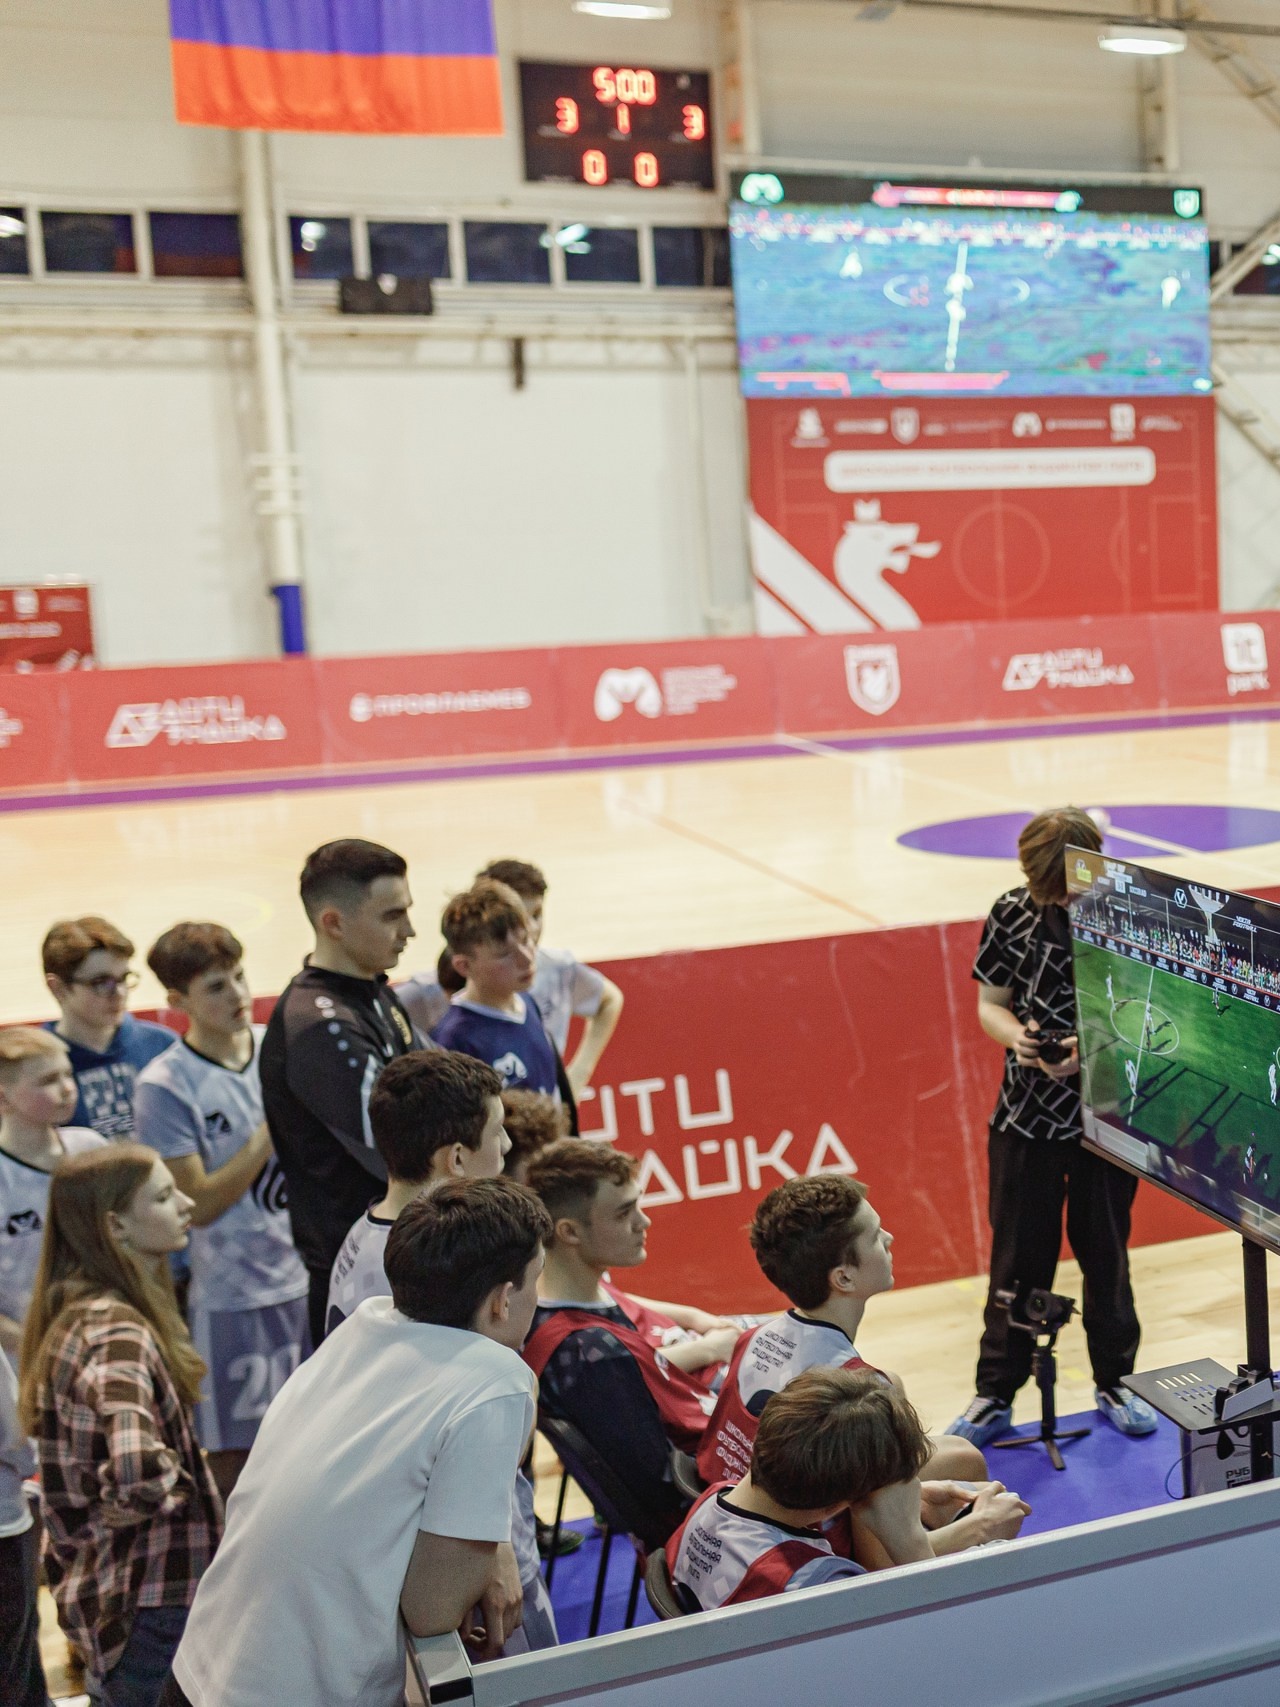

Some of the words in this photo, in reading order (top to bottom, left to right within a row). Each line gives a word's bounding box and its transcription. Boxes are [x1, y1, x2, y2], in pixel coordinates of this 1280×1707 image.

[555, 97, 579, 134] 3
[683, 105, 705, 140] 3
[583, 149, 607, 186] 0
[634, 152, 659, 187] 0
